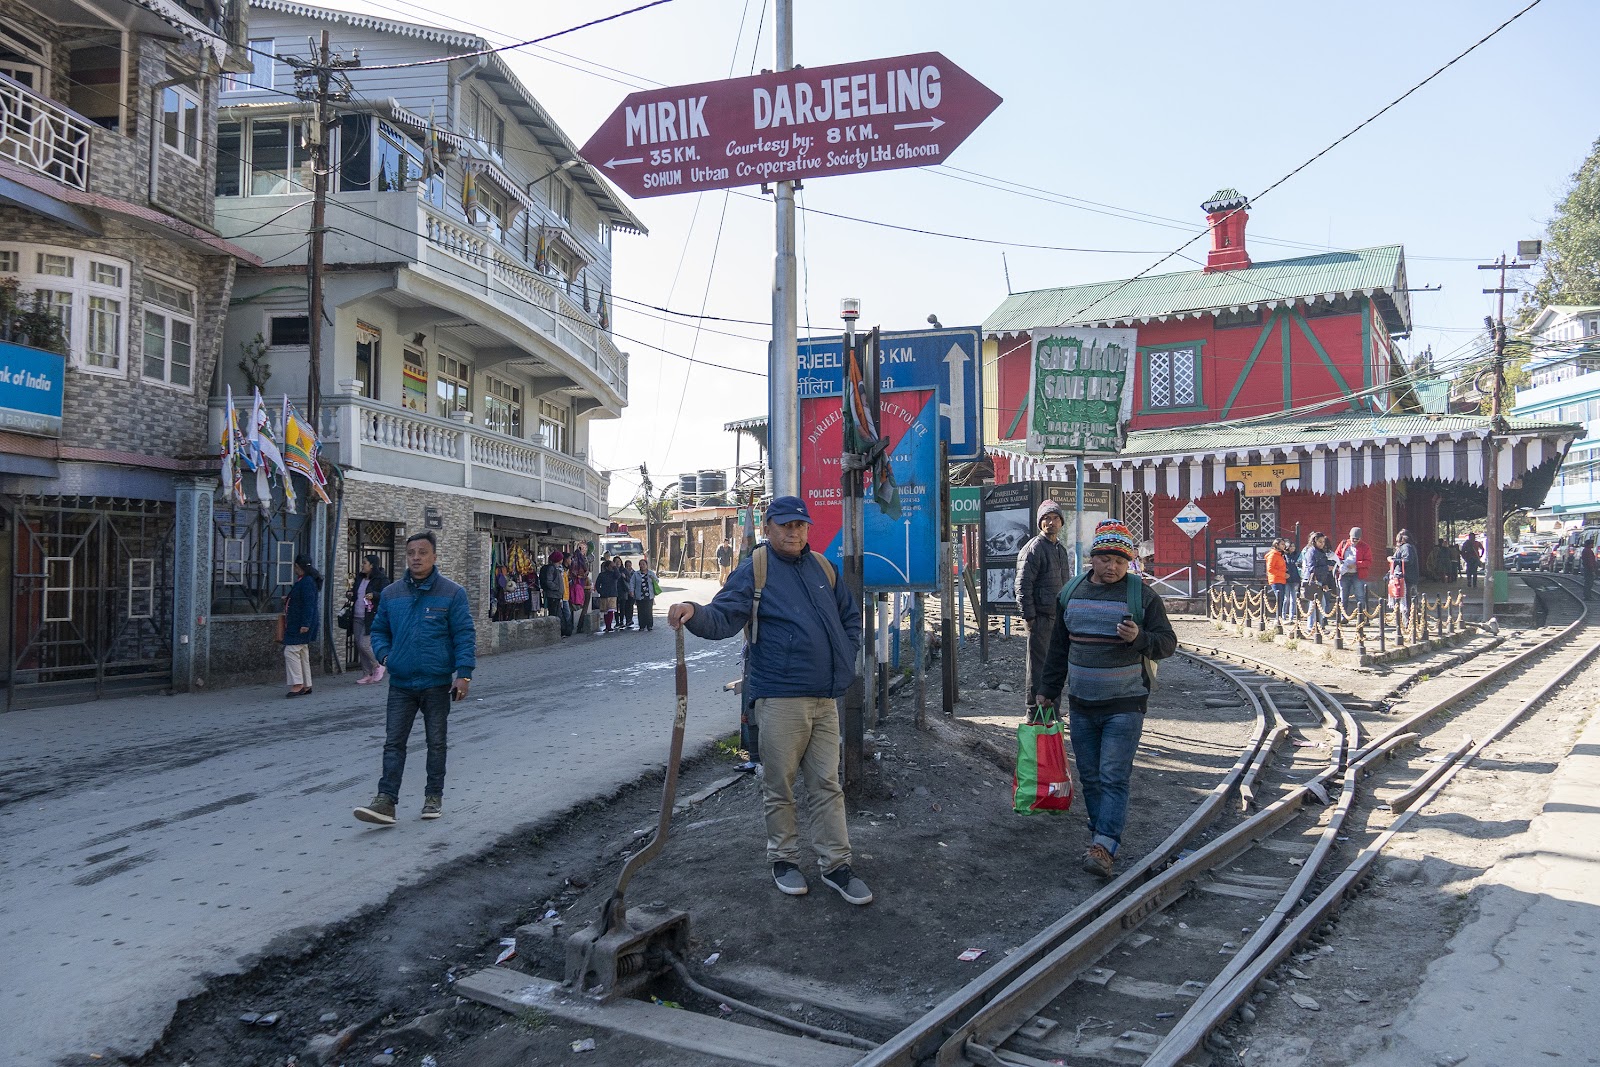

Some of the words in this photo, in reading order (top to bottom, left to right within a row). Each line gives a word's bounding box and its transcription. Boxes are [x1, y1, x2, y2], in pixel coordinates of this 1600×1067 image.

[625, 95, 710, 147] MIRIK
[753, 65, 942, 130] DARJEELING
[726, 137, 789, 158] Courtesy
[792, 132, 815, 156] by:
[826, 127, 841, 144] 8
[643, 169, 682, 189] SOHUM
[691, 167, 729, 183] Urban
[736, 154, 822, 178] Co-operative
[826, 148, 869, 170] Society
[871, 144, 895, 162] Ltd.
[896, 142, 940, 160] Ghoom
[797, 352, 844, 370] RJEEL
[890, 347, 916, 364] KM.
[1039, 345, 1078, 371] SAFE
[1079, 346, 1129, 373] DRIVE
[13, 369, 26, 386] of
[26, 372, 52, 391] India
[1044, 375, 1085, 400] SAVE
[1087, 376, 1119, 402] LIFE
[6, 413, 48, 429] BRANCH
[808, 407, 844, 444] DARJEELI
[898, 408, 928, 438] POLICE
[1047, 420, 1110, 434] DARJEELING
[808, 487, 835, 498] POLICE
[1052, 496, 1077, 504] HIMALAY
[1084, 497, 1108, 505] RAILWAY
